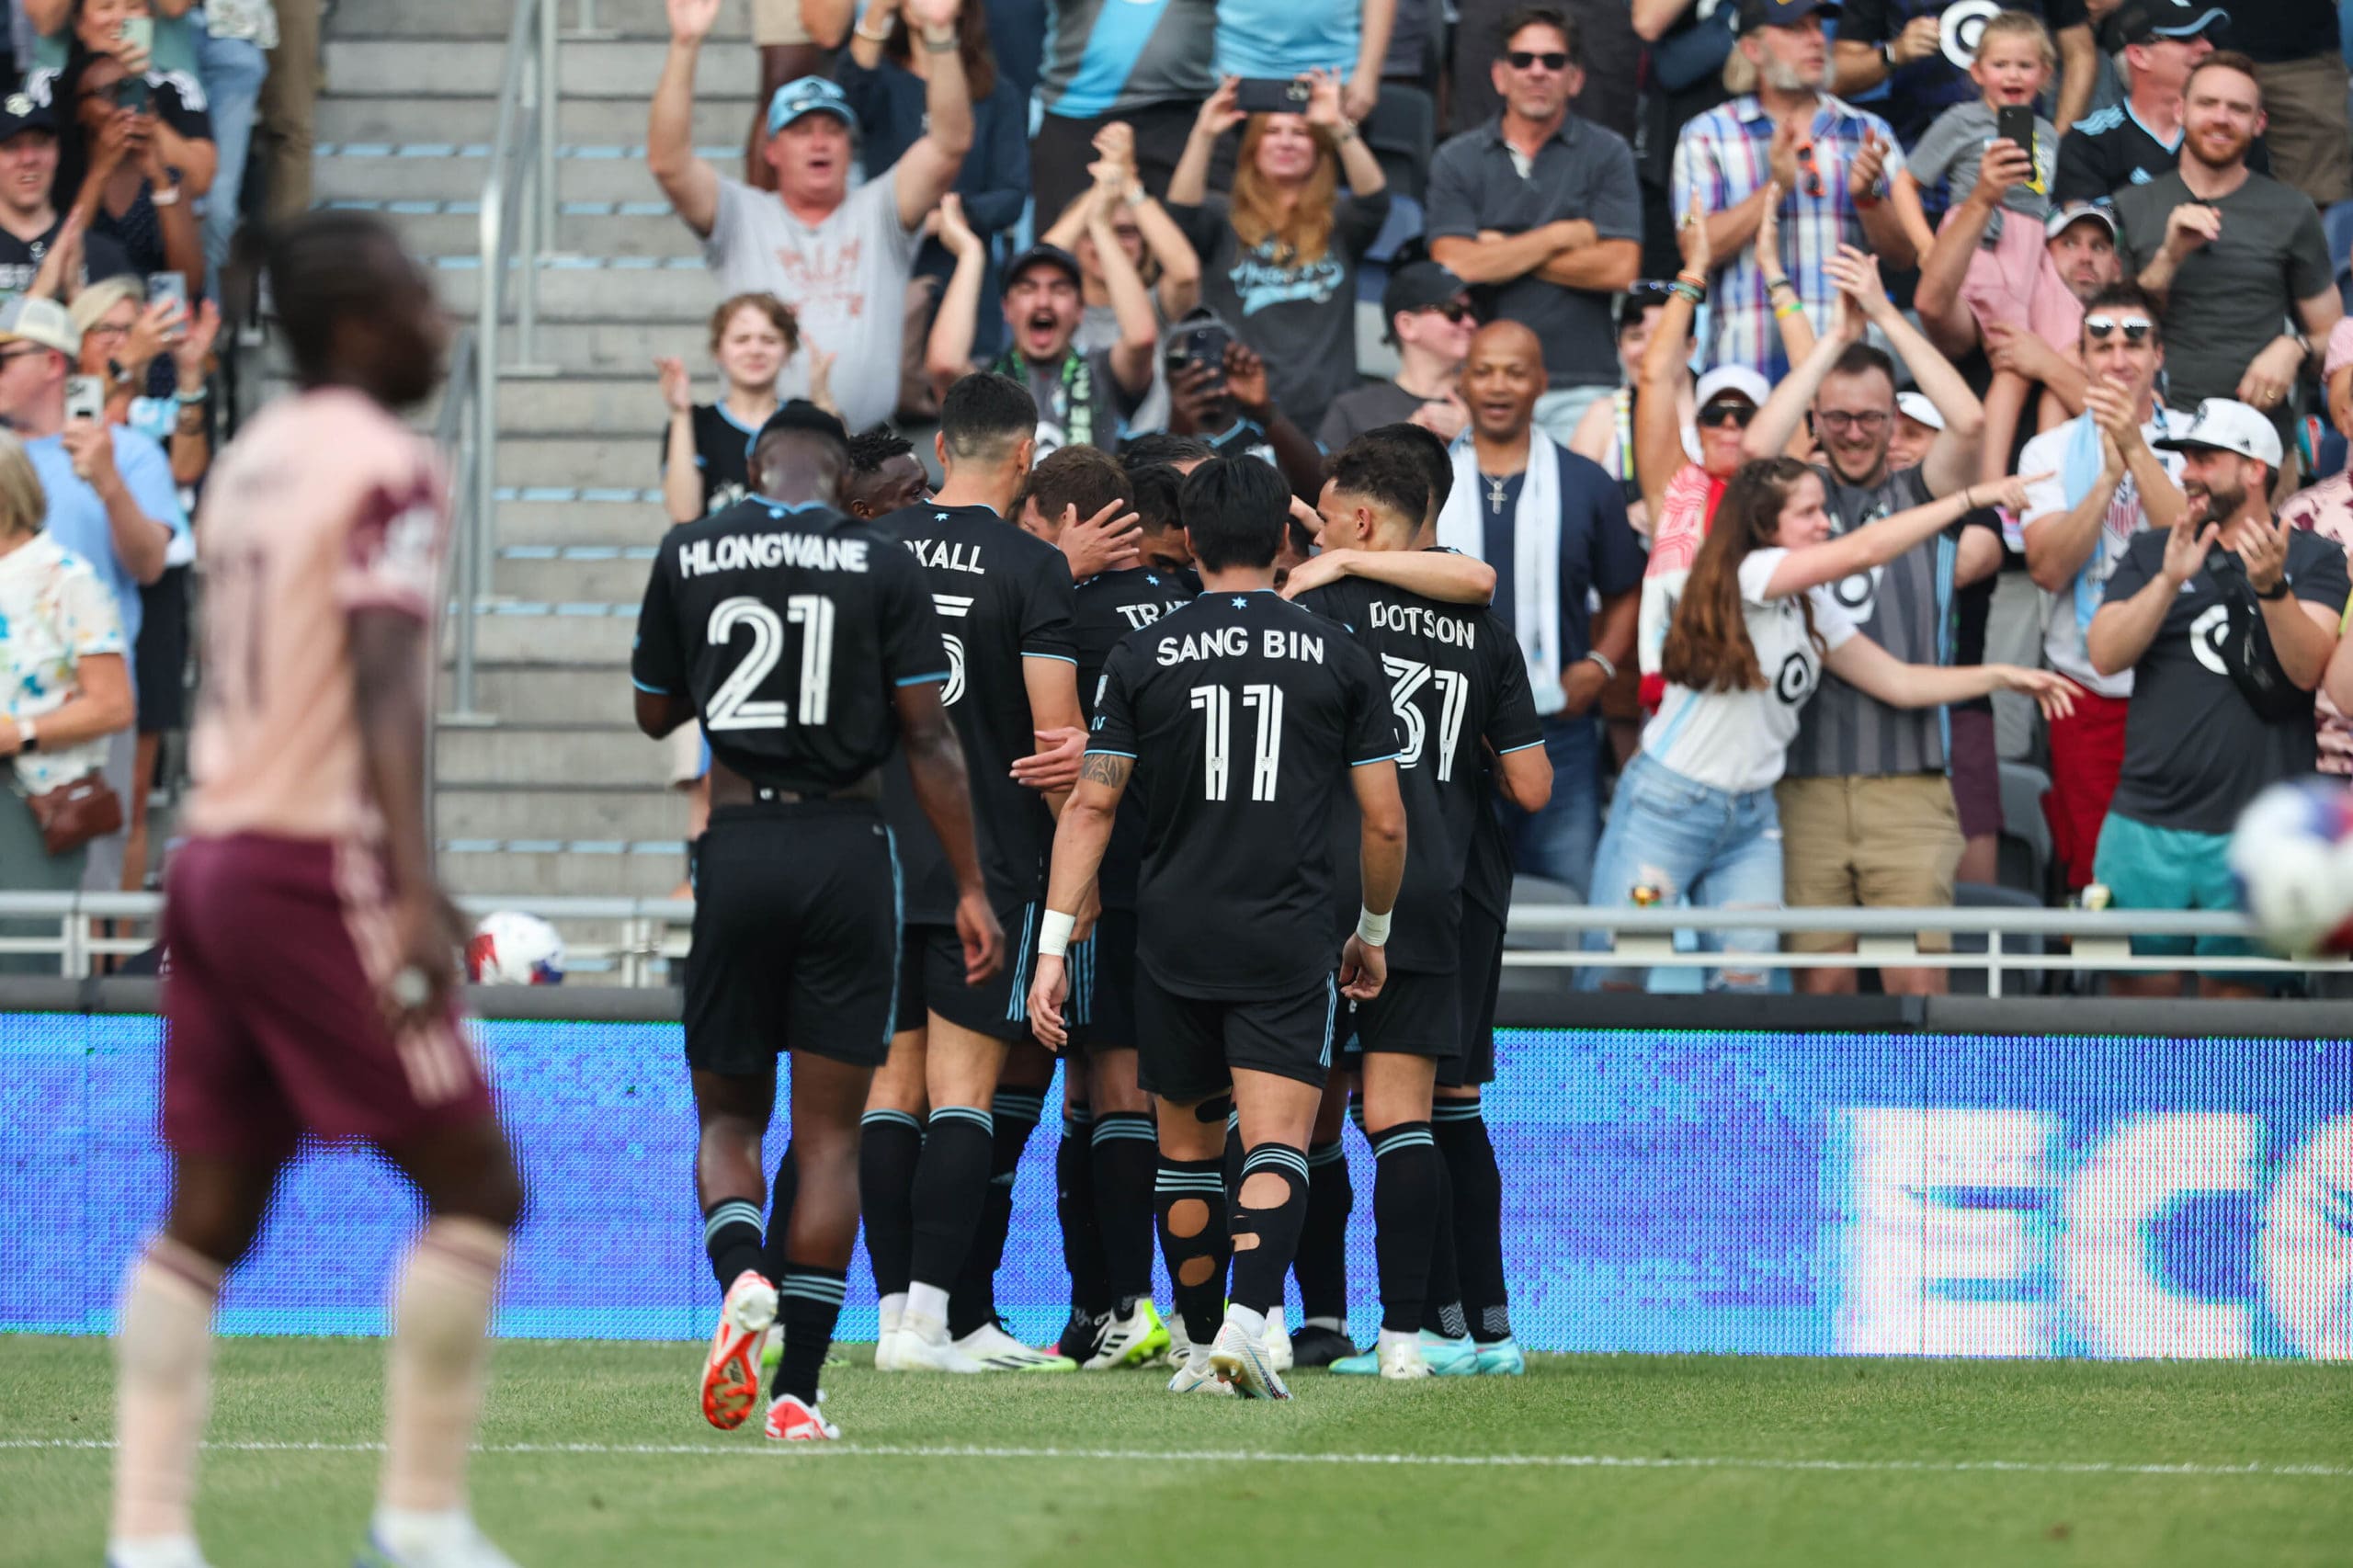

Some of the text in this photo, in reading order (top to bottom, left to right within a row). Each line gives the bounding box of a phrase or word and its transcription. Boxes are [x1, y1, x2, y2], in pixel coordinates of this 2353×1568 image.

[679, 532, 870, 578] HLONGWANE
[903, 538, 985, 574] XALL
[1156, 626, 1324, 665] SANG BIN
[1370, 600, 1475, 650] DOTSON
[706, 595, 835, 731] 21
[1380, 652, 1469, 782] 31
[1189, 684, 1284, 801] 11
